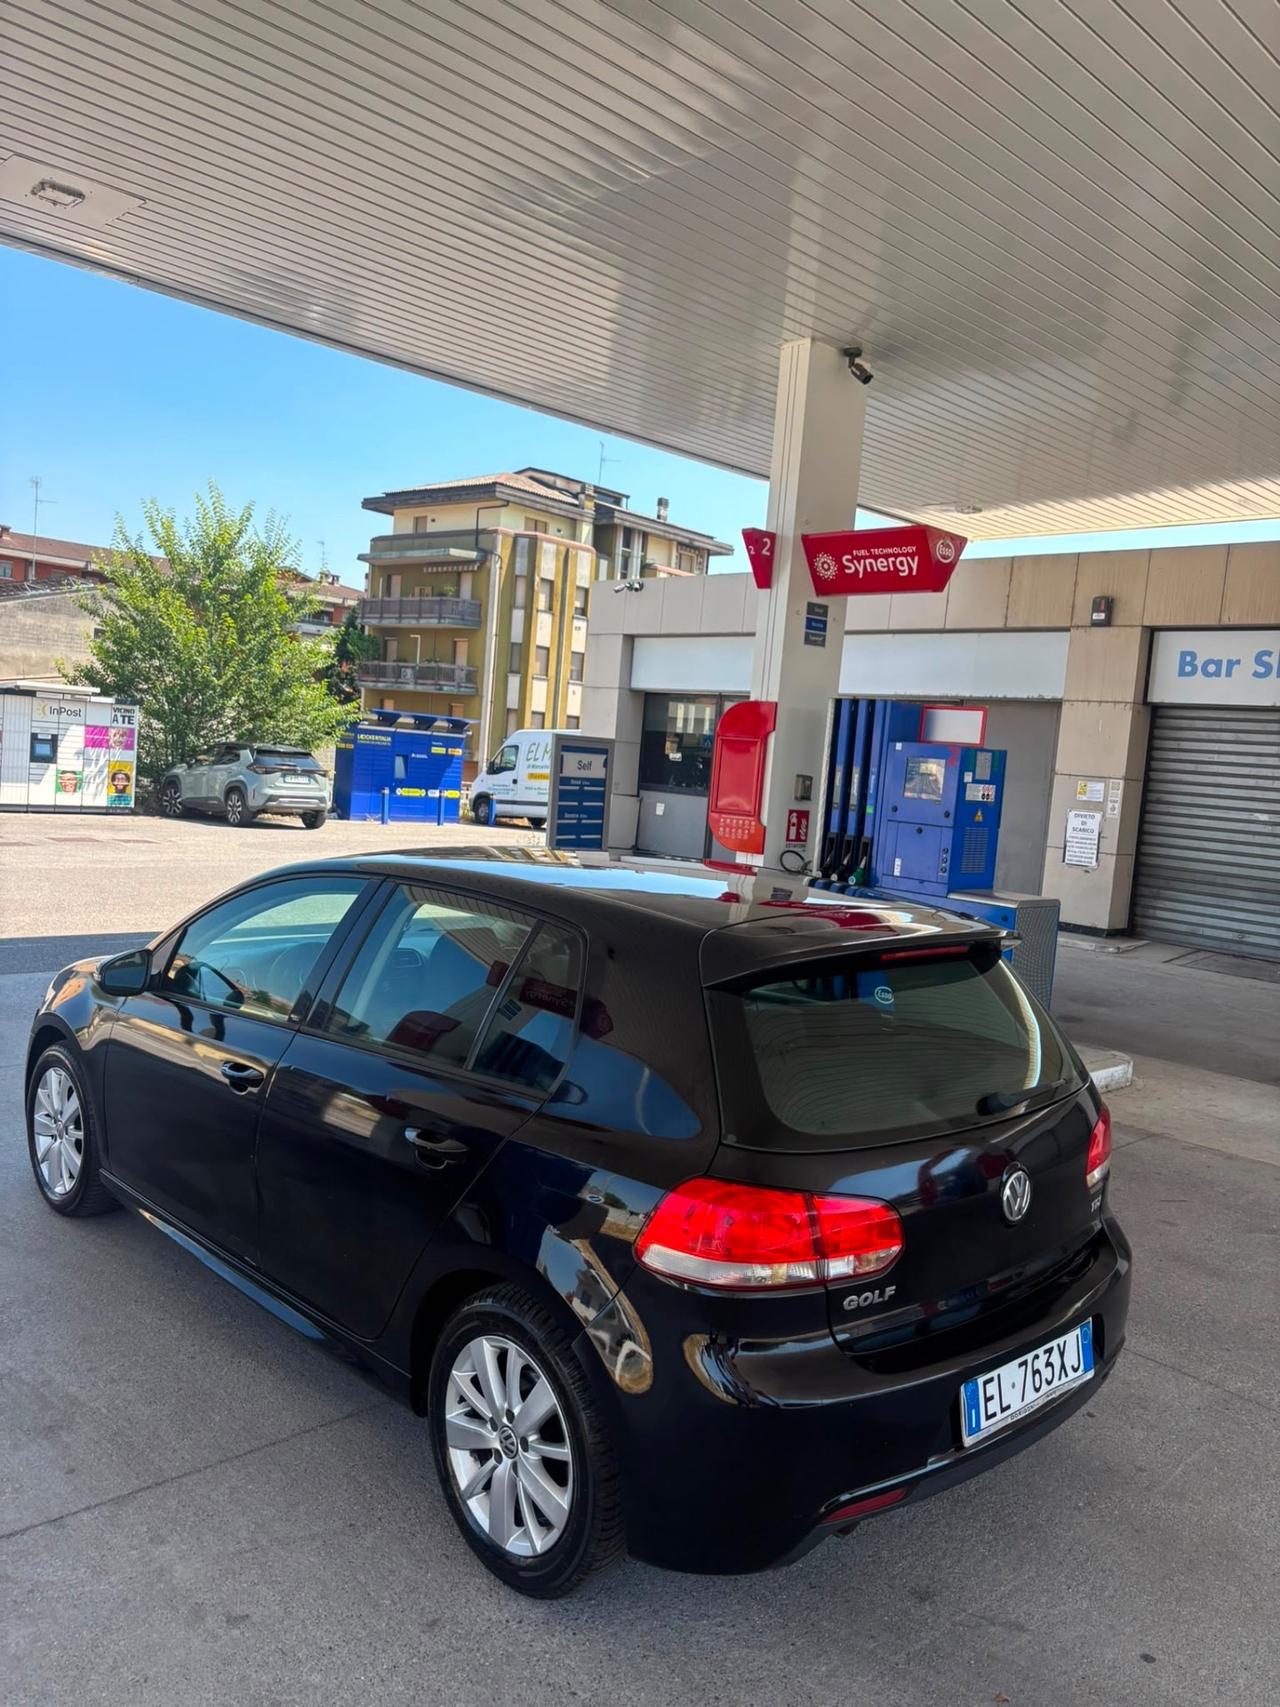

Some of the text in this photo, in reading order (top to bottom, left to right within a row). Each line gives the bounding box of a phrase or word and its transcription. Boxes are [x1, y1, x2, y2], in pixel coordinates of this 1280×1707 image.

[748, 545, 756, 555] 2
[762, 538, 771, 556] 2
[853, 545, 917, 557] FUEL TECHNOLOGY
[938, 543, 952, 557] Esso
[841, 555, 919, 578] Synergy
[1178, 649, 1280, 679] Bar S
[49, 706, 82, 718] InPost
[112, 706, 135, 714] VICINO
[112, 714, 135, 725] A TE
[577, 759, 592, 772] Self
[1074, 812, 1096, 820] DIVIETO
[1071, 826, 1095, 834] SCARICO
[842, 1285, 897, 1311] GOLF
[982, 1373, 1012, 1421] EL
[1018, 1333, 1081, 1403] 763XJ
